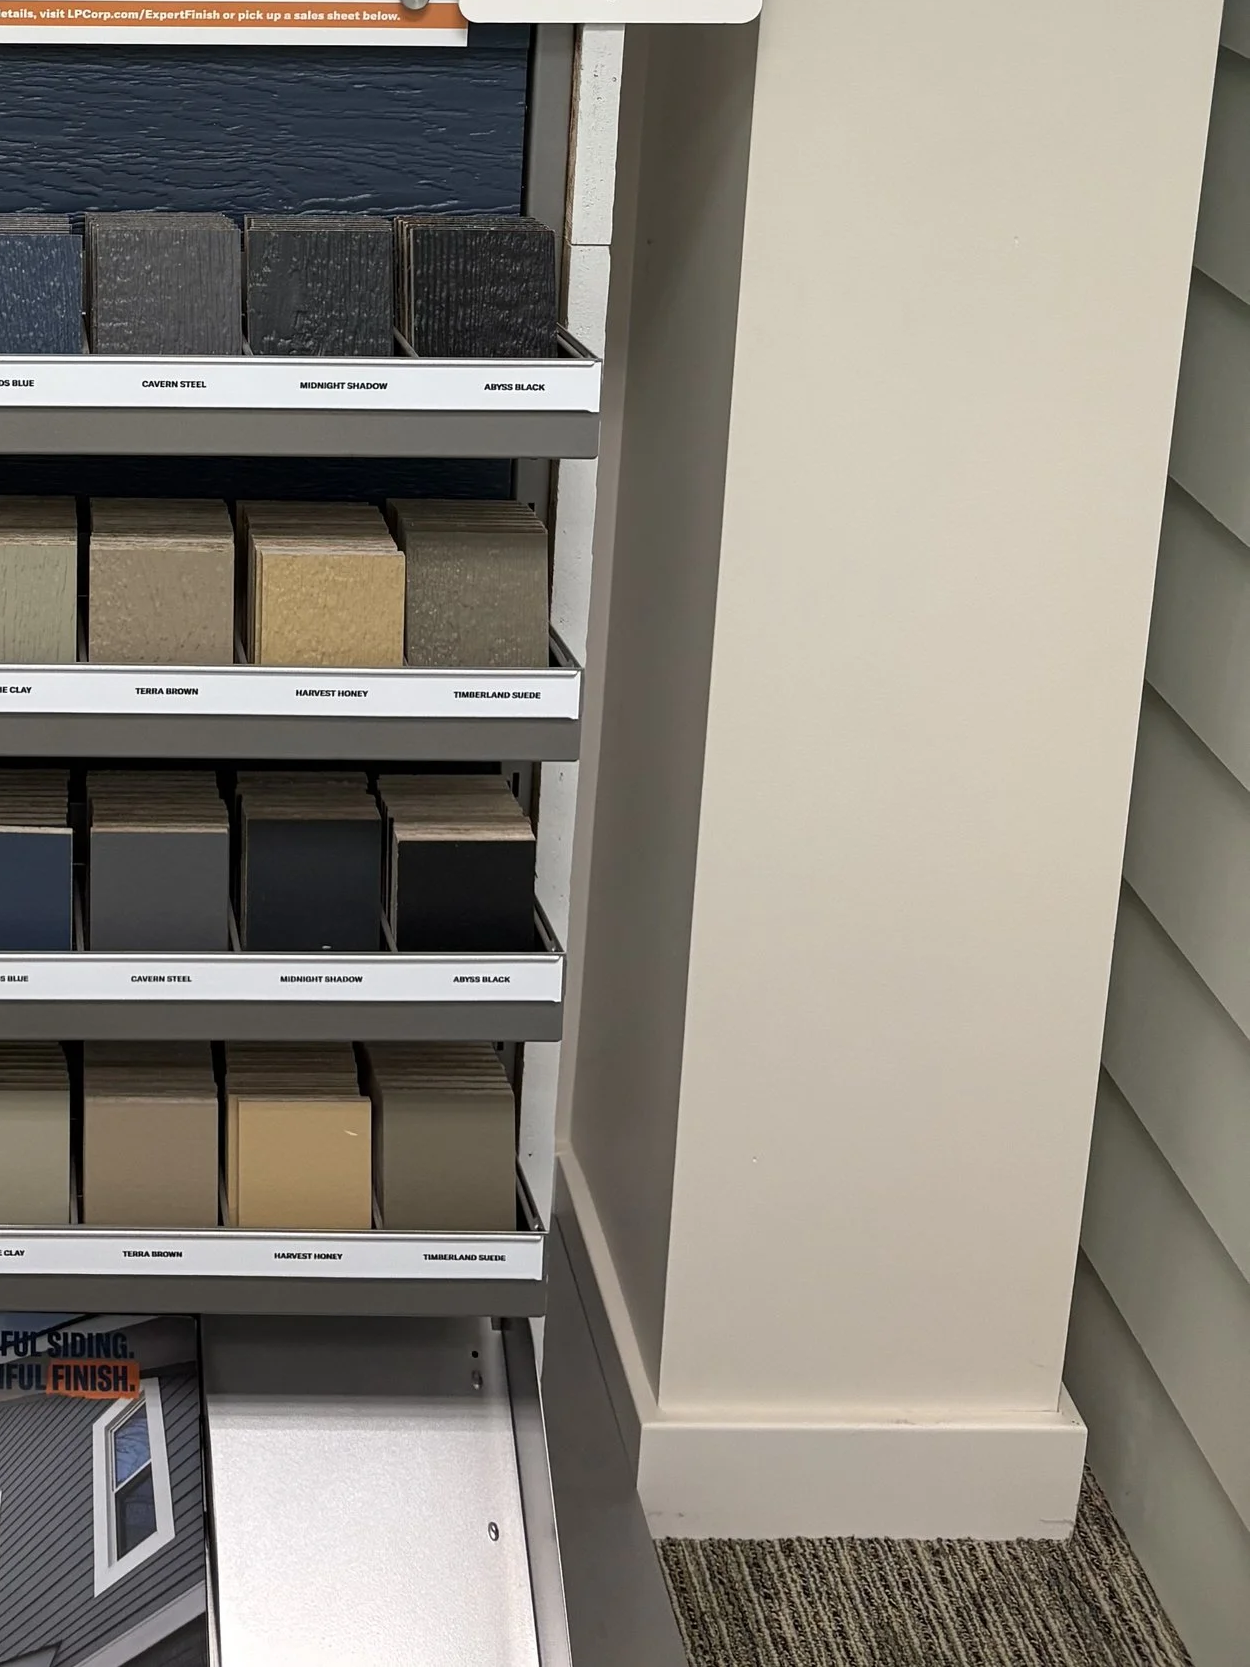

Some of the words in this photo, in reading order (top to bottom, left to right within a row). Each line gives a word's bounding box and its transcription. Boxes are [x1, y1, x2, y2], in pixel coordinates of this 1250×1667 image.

[39, 8, 65, 18] visit
[67, 8, 220, 21] LPCorp.com/ExpertFinish
[222, 12, 236, 20] or
[238, 10, 264, 22] pick
[266, 12, 282, 22] up
[283, 12, 292, 20] a
[293, 10, 325, 20] sales
[326, 10, 360, 20] sheet
[362, 10, 400, 21] below.
[12, 379, 34, 387] BLUE
[295, 689, 336, 697] HARVEST
[337, 690, 368, 698] HONEY
[453, 691, 511, 699] TIMBERLAND
[512, 692, 541, 700] SUEDE
[280, 975, 323, 983] MIDNIGHT
[122, 1250, 150, 1258] TERRA
[47, 1331, 135, 1359] SIDING.
[52, 1364, 135, 1392] FINISH.
